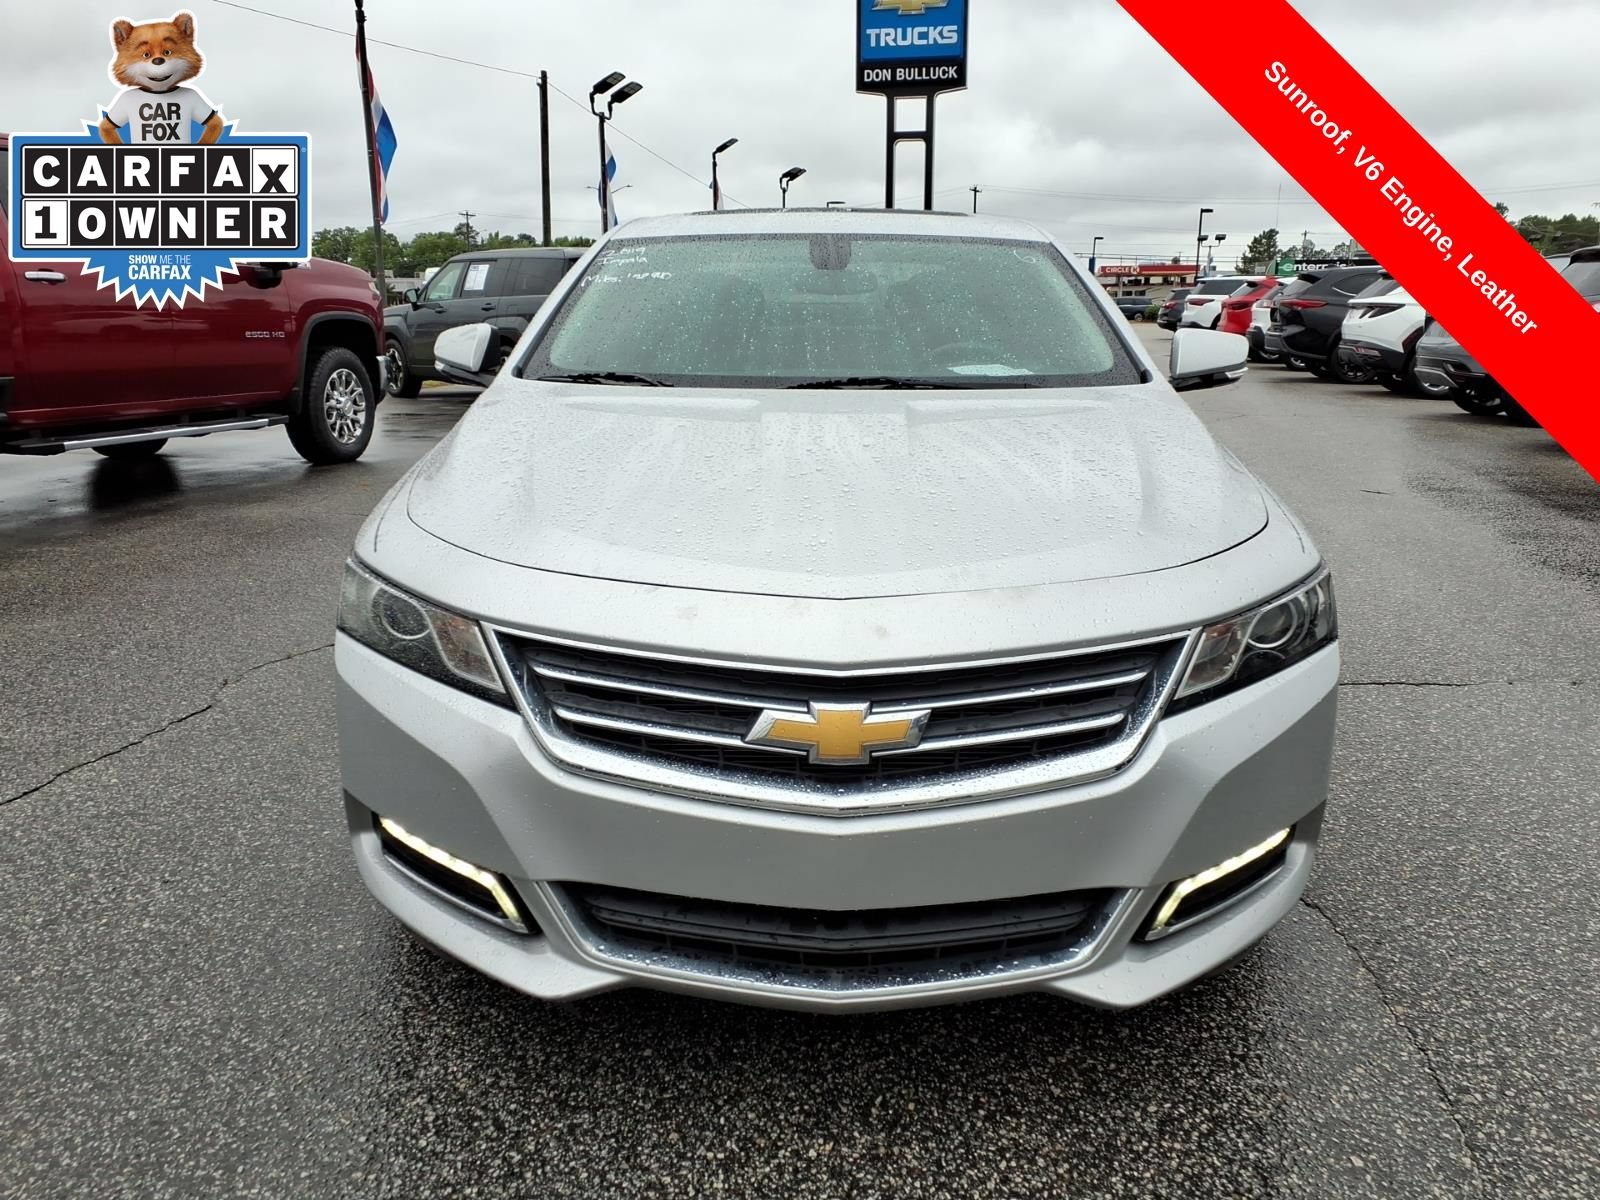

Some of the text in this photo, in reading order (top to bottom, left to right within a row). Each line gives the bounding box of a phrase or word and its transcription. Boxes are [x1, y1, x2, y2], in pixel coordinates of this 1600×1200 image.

[866, 25, 958, 47] TRUCKS
[864, 66, 958, 82] DON BULLUCK
